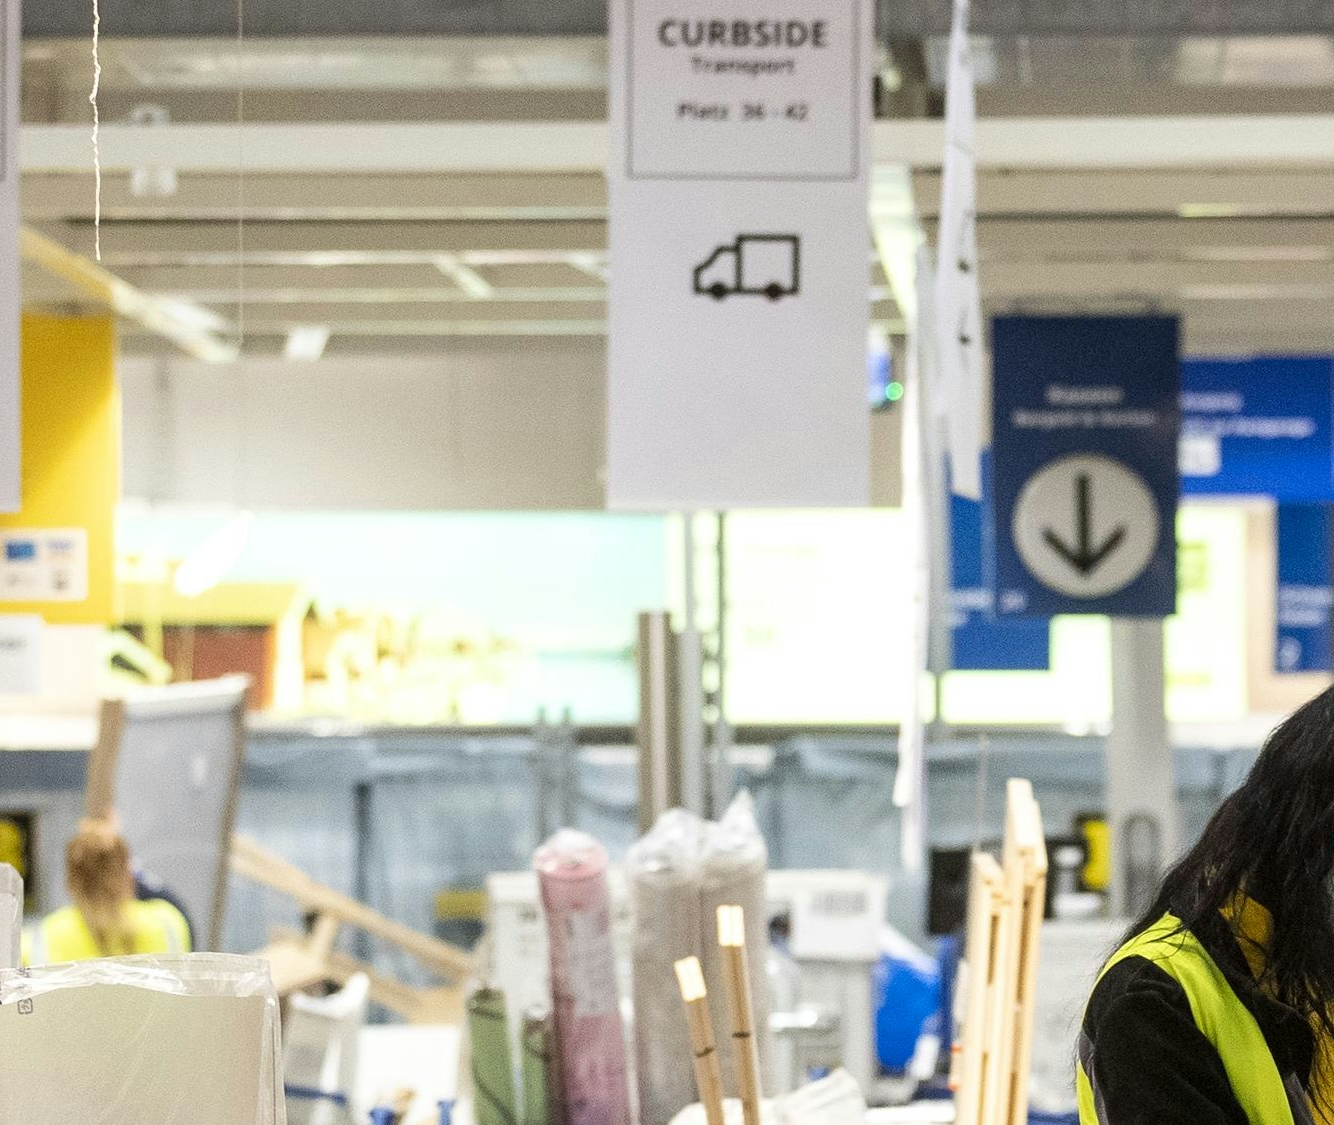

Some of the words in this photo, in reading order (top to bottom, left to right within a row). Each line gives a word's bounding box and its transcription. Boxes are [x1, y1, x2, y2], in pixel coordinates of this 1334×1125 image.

[657, 19, 828, 48] CURBSIDE
[691, 55, 795, 78] Transport
[676, 103, 729, 122] Platz
[742, 103, 765, 122] 36
[785, 103, 810, 122] 42
